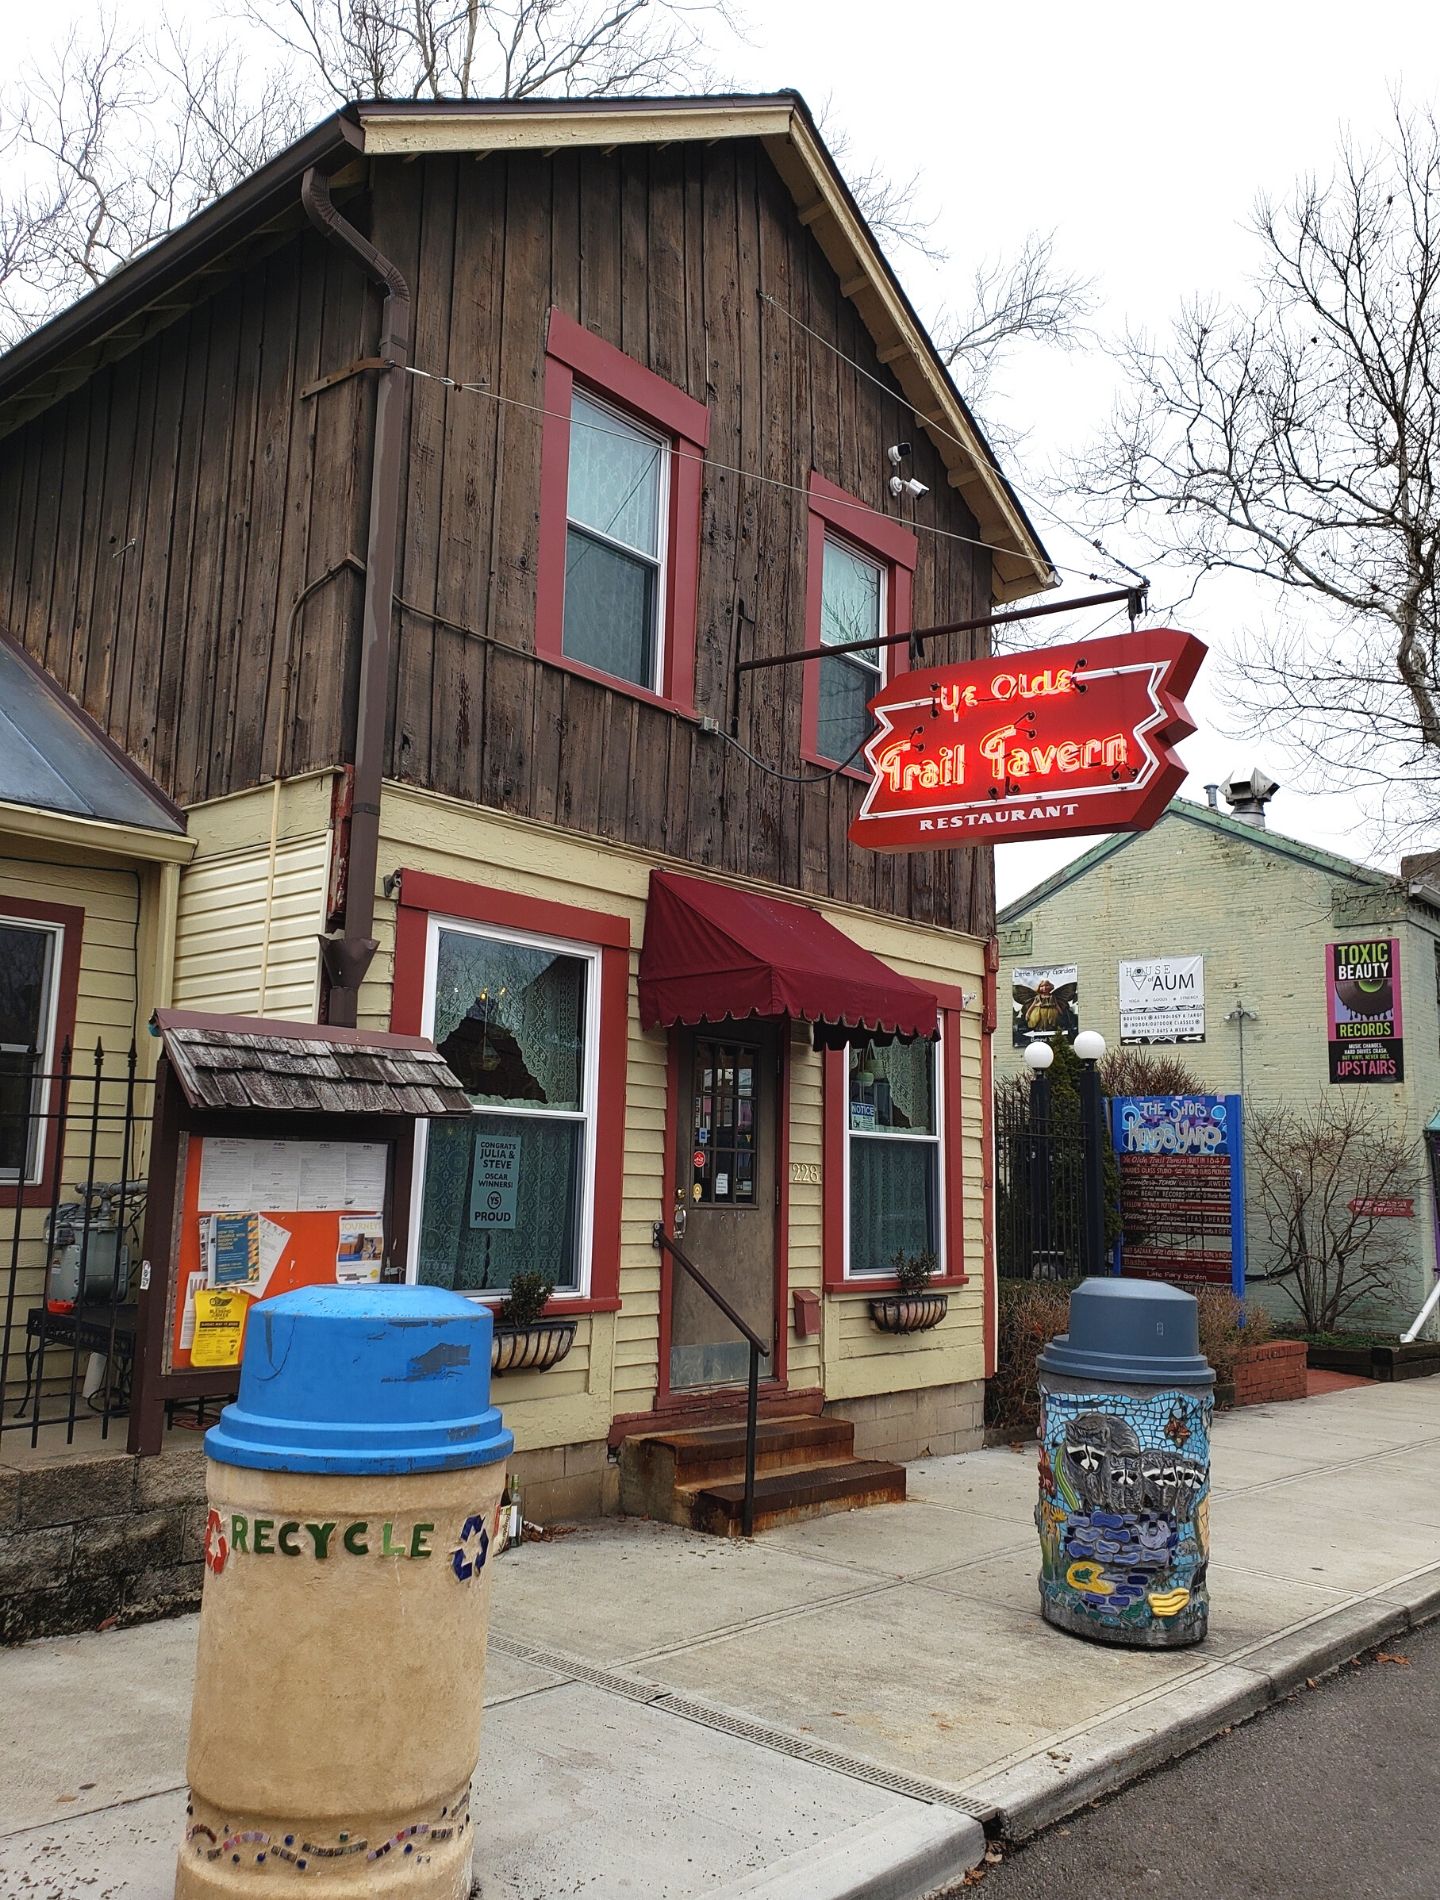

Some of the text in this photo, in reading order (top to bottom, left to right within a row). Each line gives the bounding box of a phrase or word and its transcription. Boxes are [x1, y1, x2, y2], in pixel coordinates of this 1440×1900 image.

[940, 669, 1075, 722] Ye Olde
[878, 724, 1128, 792] Trail Tavern
[920, 803, 1079, 831] RESTAURANT
[1338, 943, 1388, 965] TOXIC
[1033, 970, 1051, 978] Fairy
[1338, 962, 1389, 980] BEAUTY
[1152, 973, 1194, 991] AUM
[1340, 1022, 1391, 1037] RECORDS
[1338, 1060, 1397, 1076] UPSTAIRS
[852, 1105, 875, 1115] NOTICE
[1140, 1102, 1167, 1117] THE
[481, 1142, 516, 1150] CONGRATS
[480, 1149, 515, 1159] JULIA &
[483, 1160, 512, 1169] STEVE
[485, 1172, 508, 1180] OSCAR
[792, 1164, 819, 1182] 228
[479, 1180, 513, 1189] WINNERS!
[490, 1197, 500, 1205] YS
[475, 1212, 511, 1222] PROUD
[231, 1512, 435, 1559] RECYCLE
